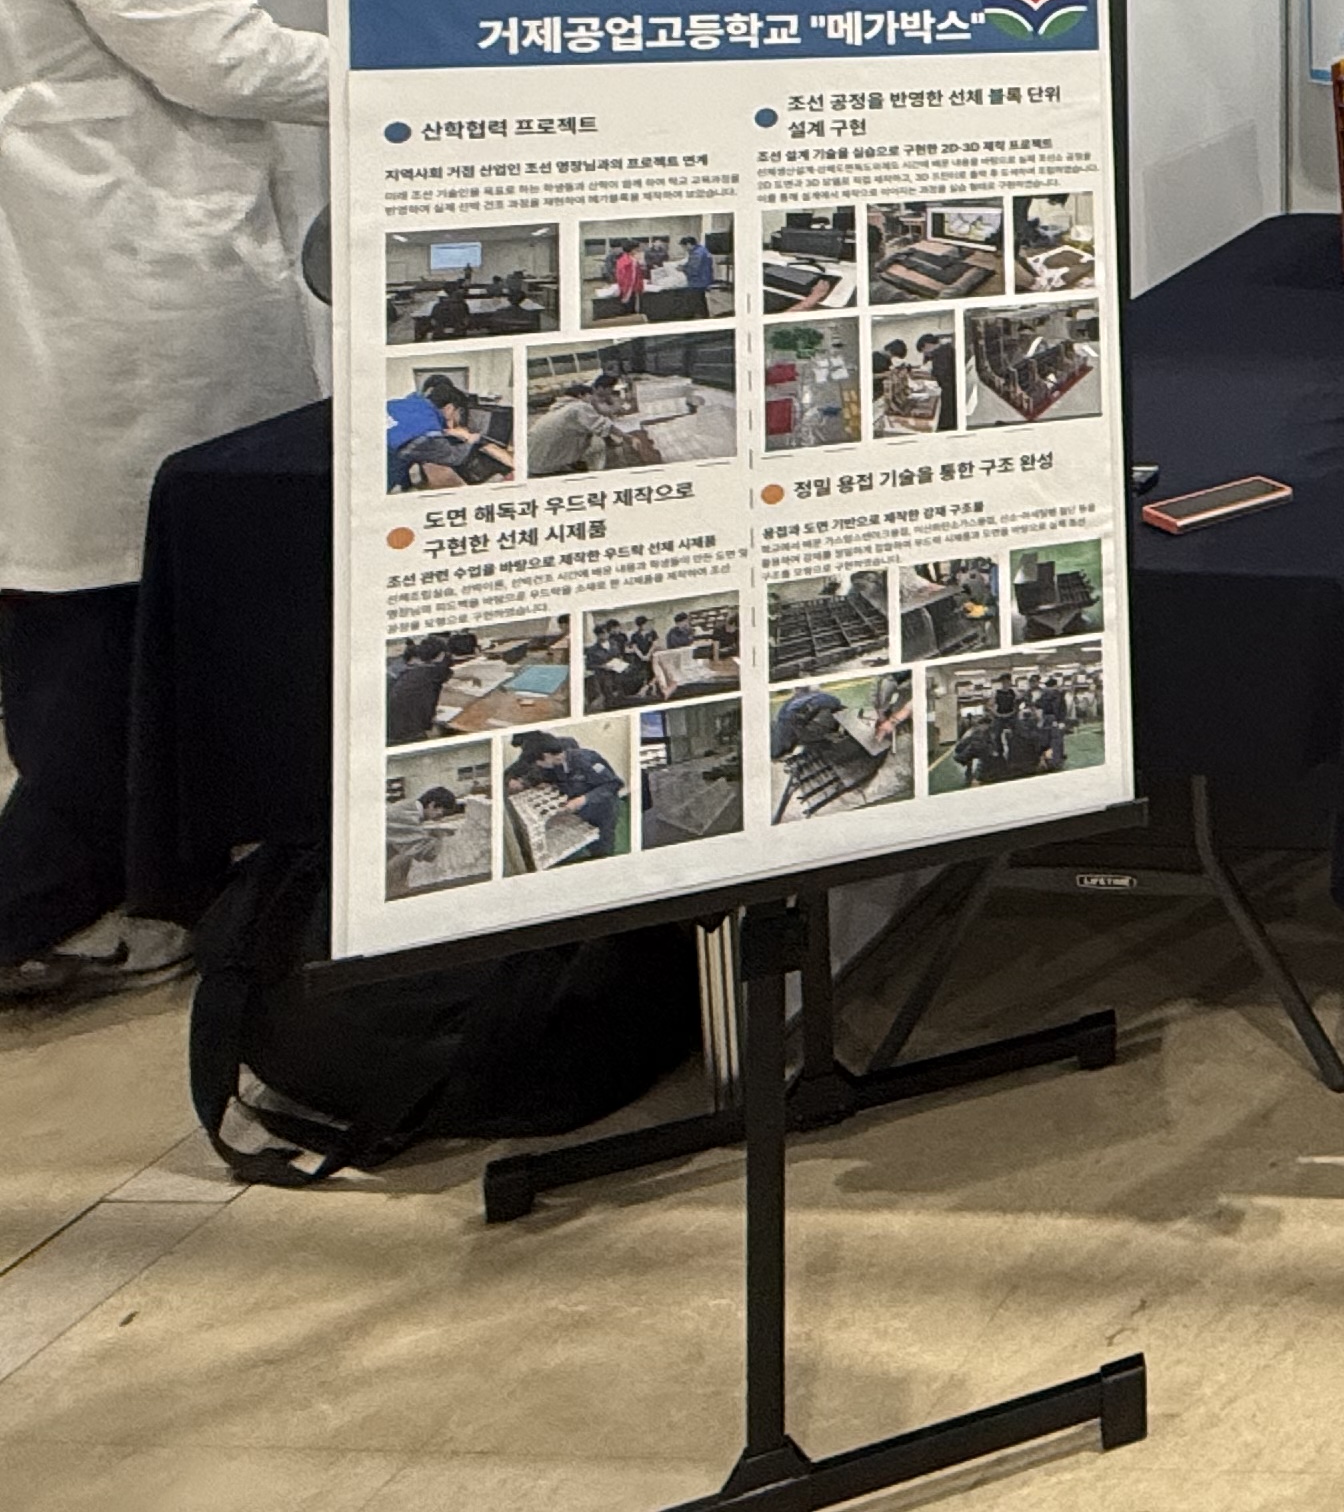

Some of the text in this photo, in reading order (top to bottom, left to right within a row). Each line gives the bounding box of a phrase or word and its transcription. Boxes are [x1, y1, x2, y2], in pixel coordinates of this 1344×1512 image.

[478, 8, 986, 54] 거제공업고등학교 "메가박스"
[788, 85, 1061, 111] 조선 공정을 반영한 선체 블록 단위
[421, 116, 599, 141] 산학협력 프로젝트
[788, 118, 867, 139] 설계 구현
[793, 451, 1054, 499] 정밀 용접 기술을 통한 구조 완성
[424, 482, 695, 530] 도면 해독과 우드락 제작으로
[424, 519, 607, 560] 구현한 선체 시제품
